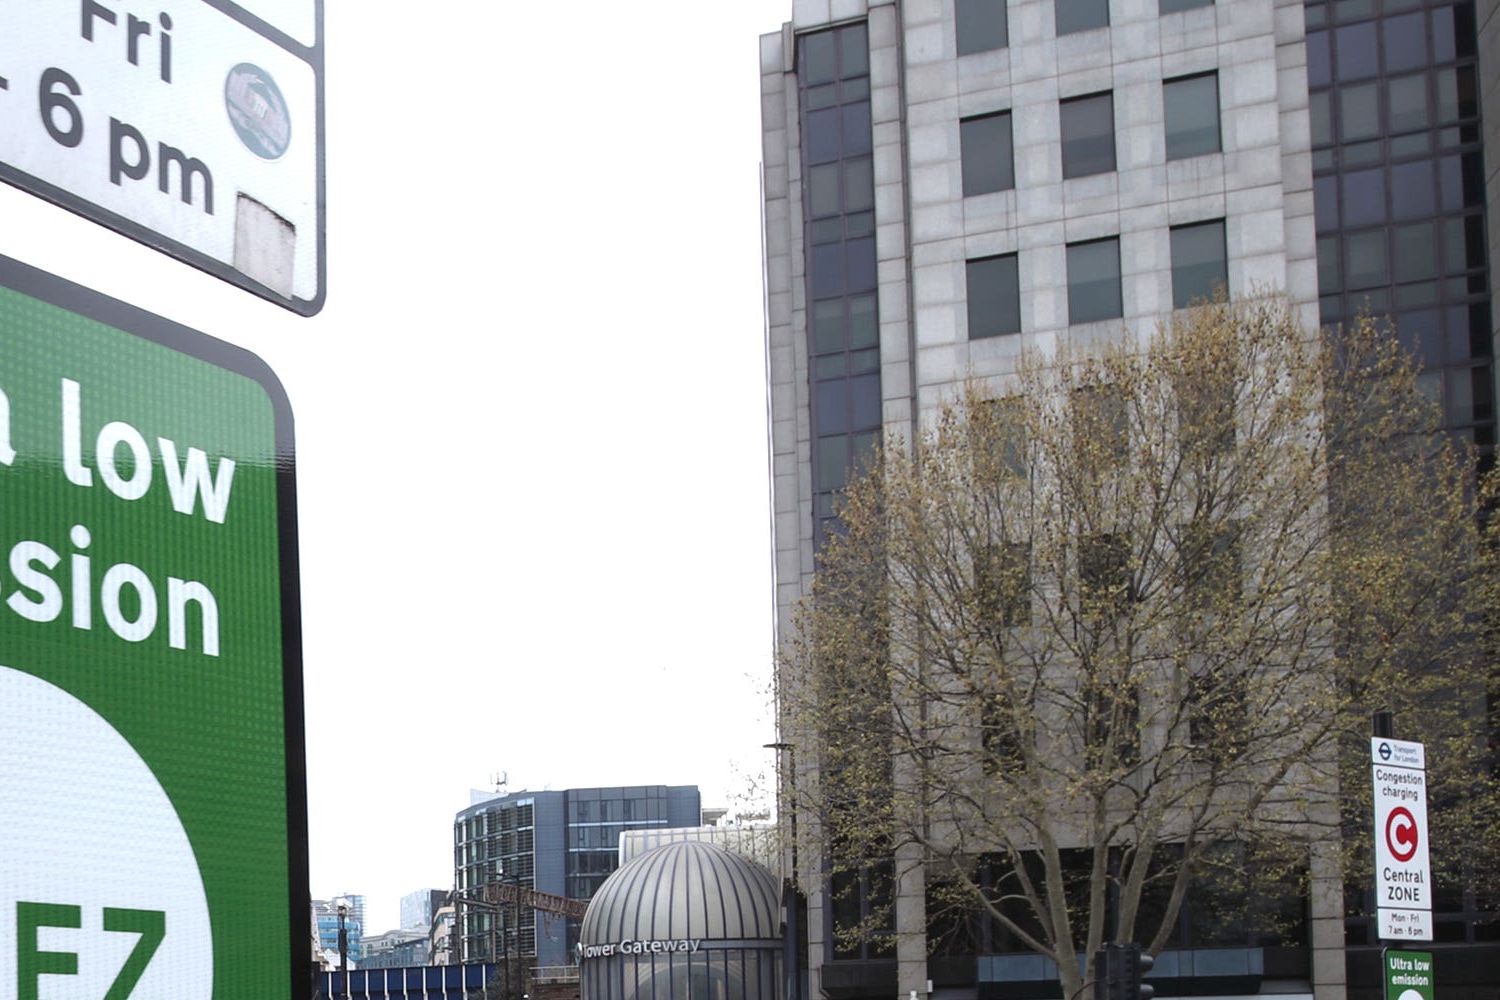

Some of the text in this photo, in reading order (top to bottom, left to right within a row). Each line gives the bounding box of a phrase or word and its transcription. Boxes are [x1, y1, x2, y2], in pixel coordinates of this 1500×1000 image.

[39, 66, 84, 149] 6
[109, 115, 215, 216] pm
[61, 377, 236, 525] low
[1376, 769, 1424, 785] Congestion
[1382, 786, 1418, 801] charging
[1383, 867, 1424, 883] Central
[1388, 886, 1420, 901] ZONE
[1391, 913, 1405, 922] Mon
[1411, 914, 1420, 922] Fri
[582, 939, 700, 959] Tower Gateway
[1390, 957, 1430, 971] Ultra low
[1392, 973, 1429, 986] emission
